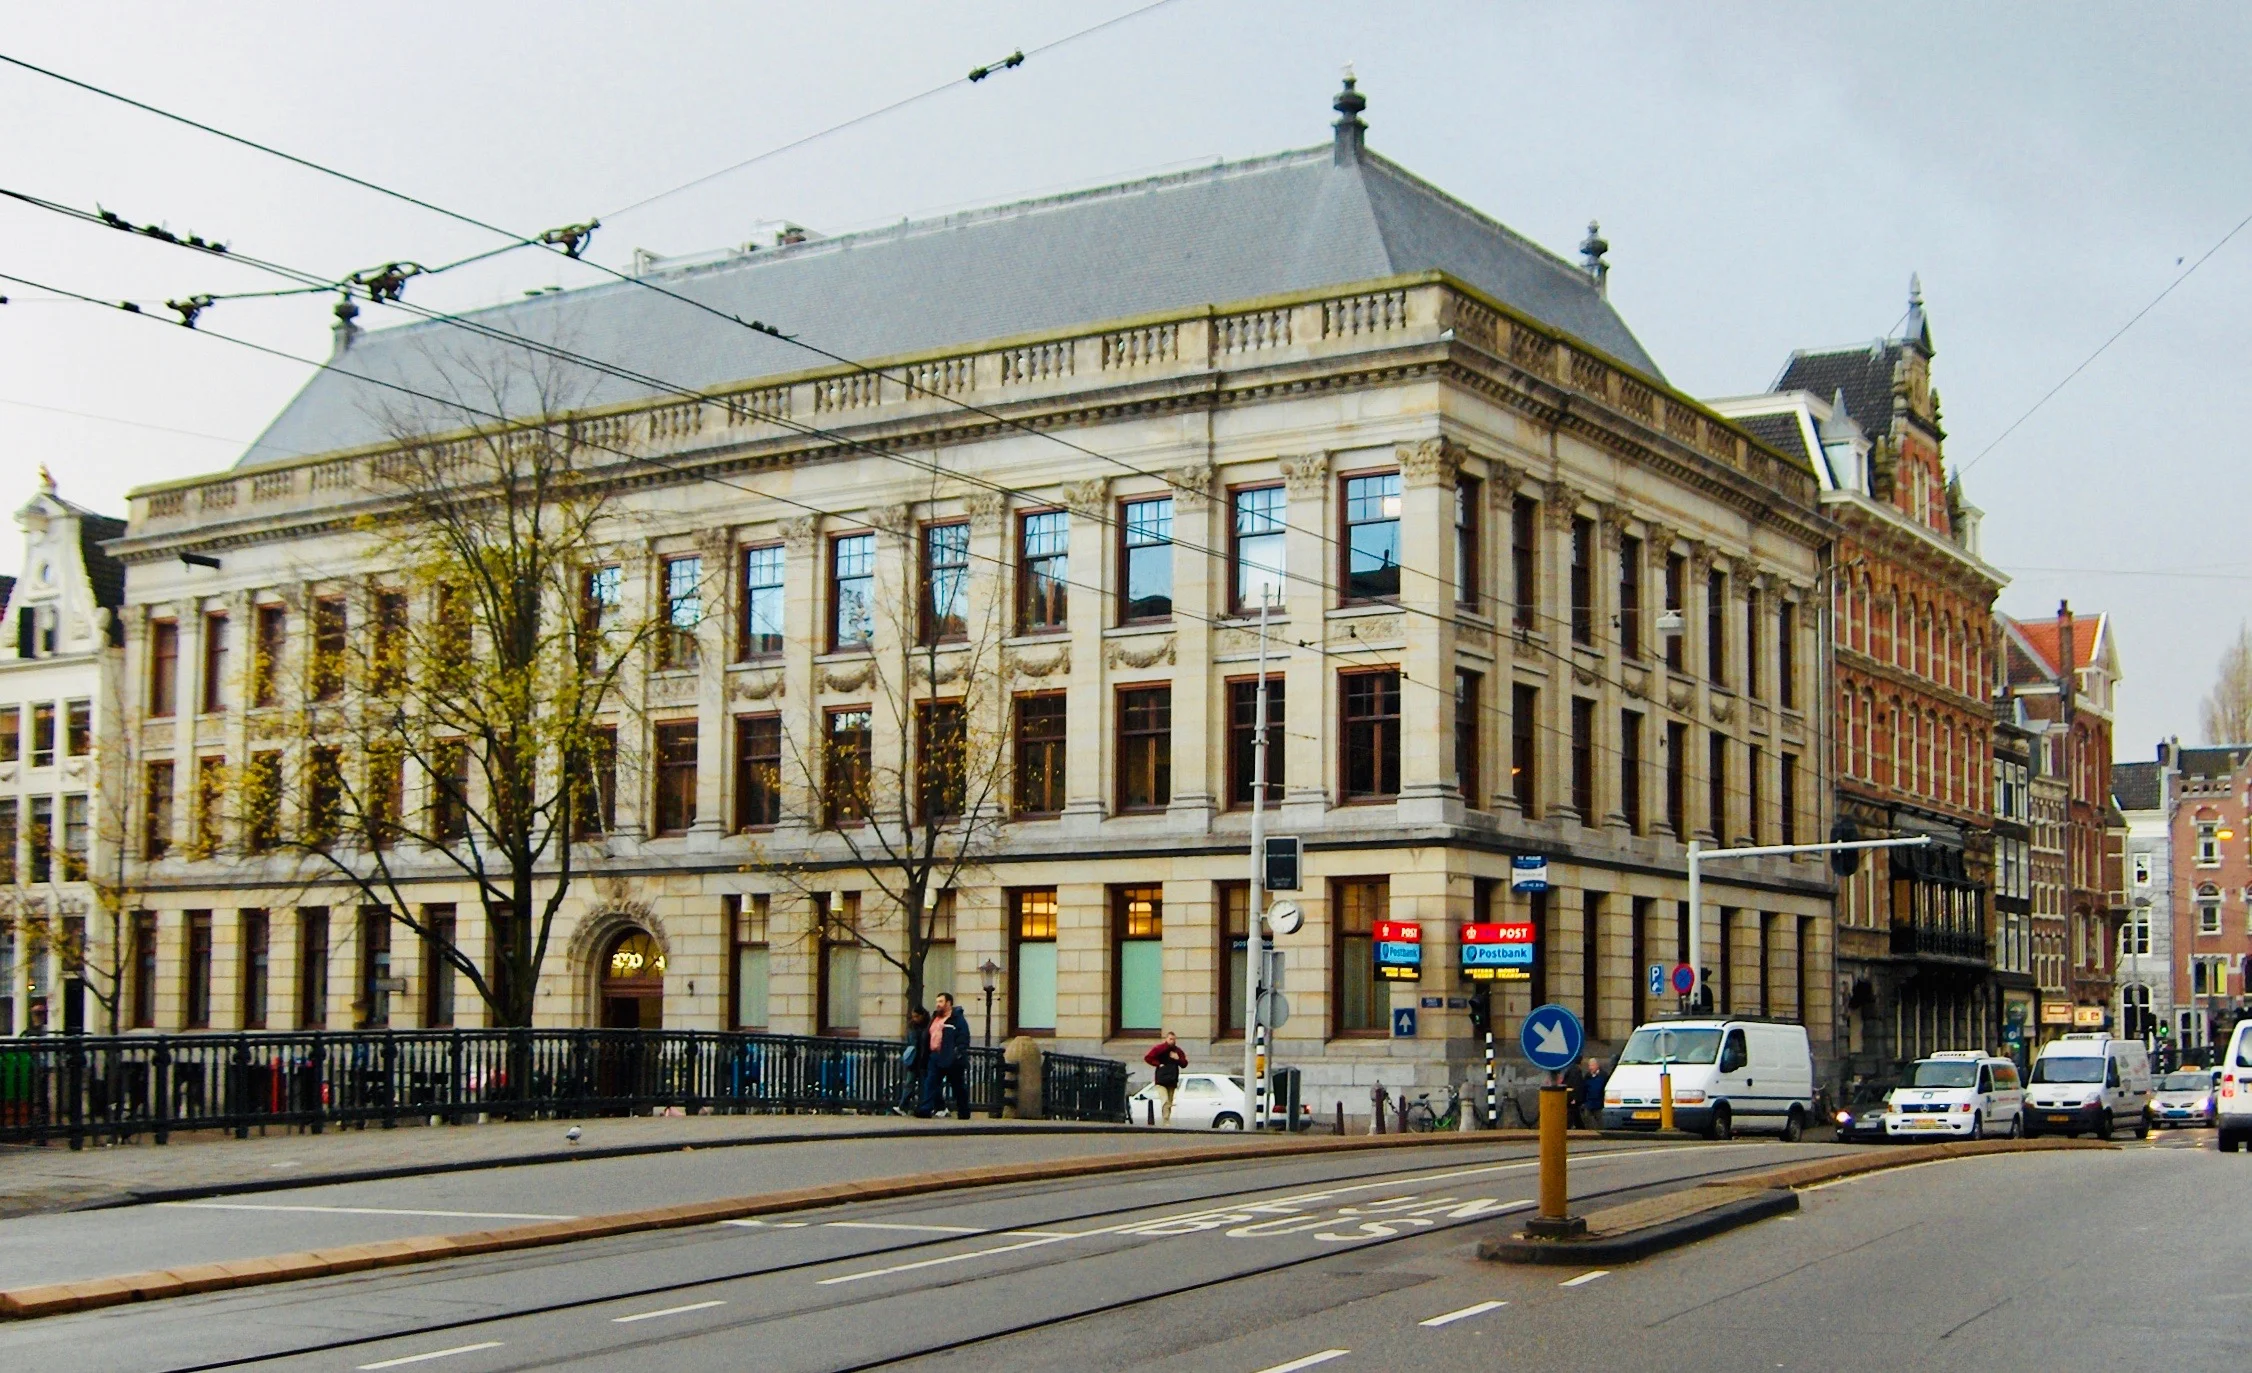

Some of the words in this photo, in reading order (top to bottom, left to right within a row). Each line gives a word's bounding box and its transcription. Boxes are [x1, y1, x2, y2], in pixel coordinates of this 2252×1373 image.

[1401, 927, 1418, 938] POST
[1499, 927, 1528, 939] POST
[1389, 946, 1418, 958] Postbank
[1479, 948, 1528, 959] Postbank
[1651, 966, 1661, 982] P
[1114, 1213, 1435, 1242] BUS
